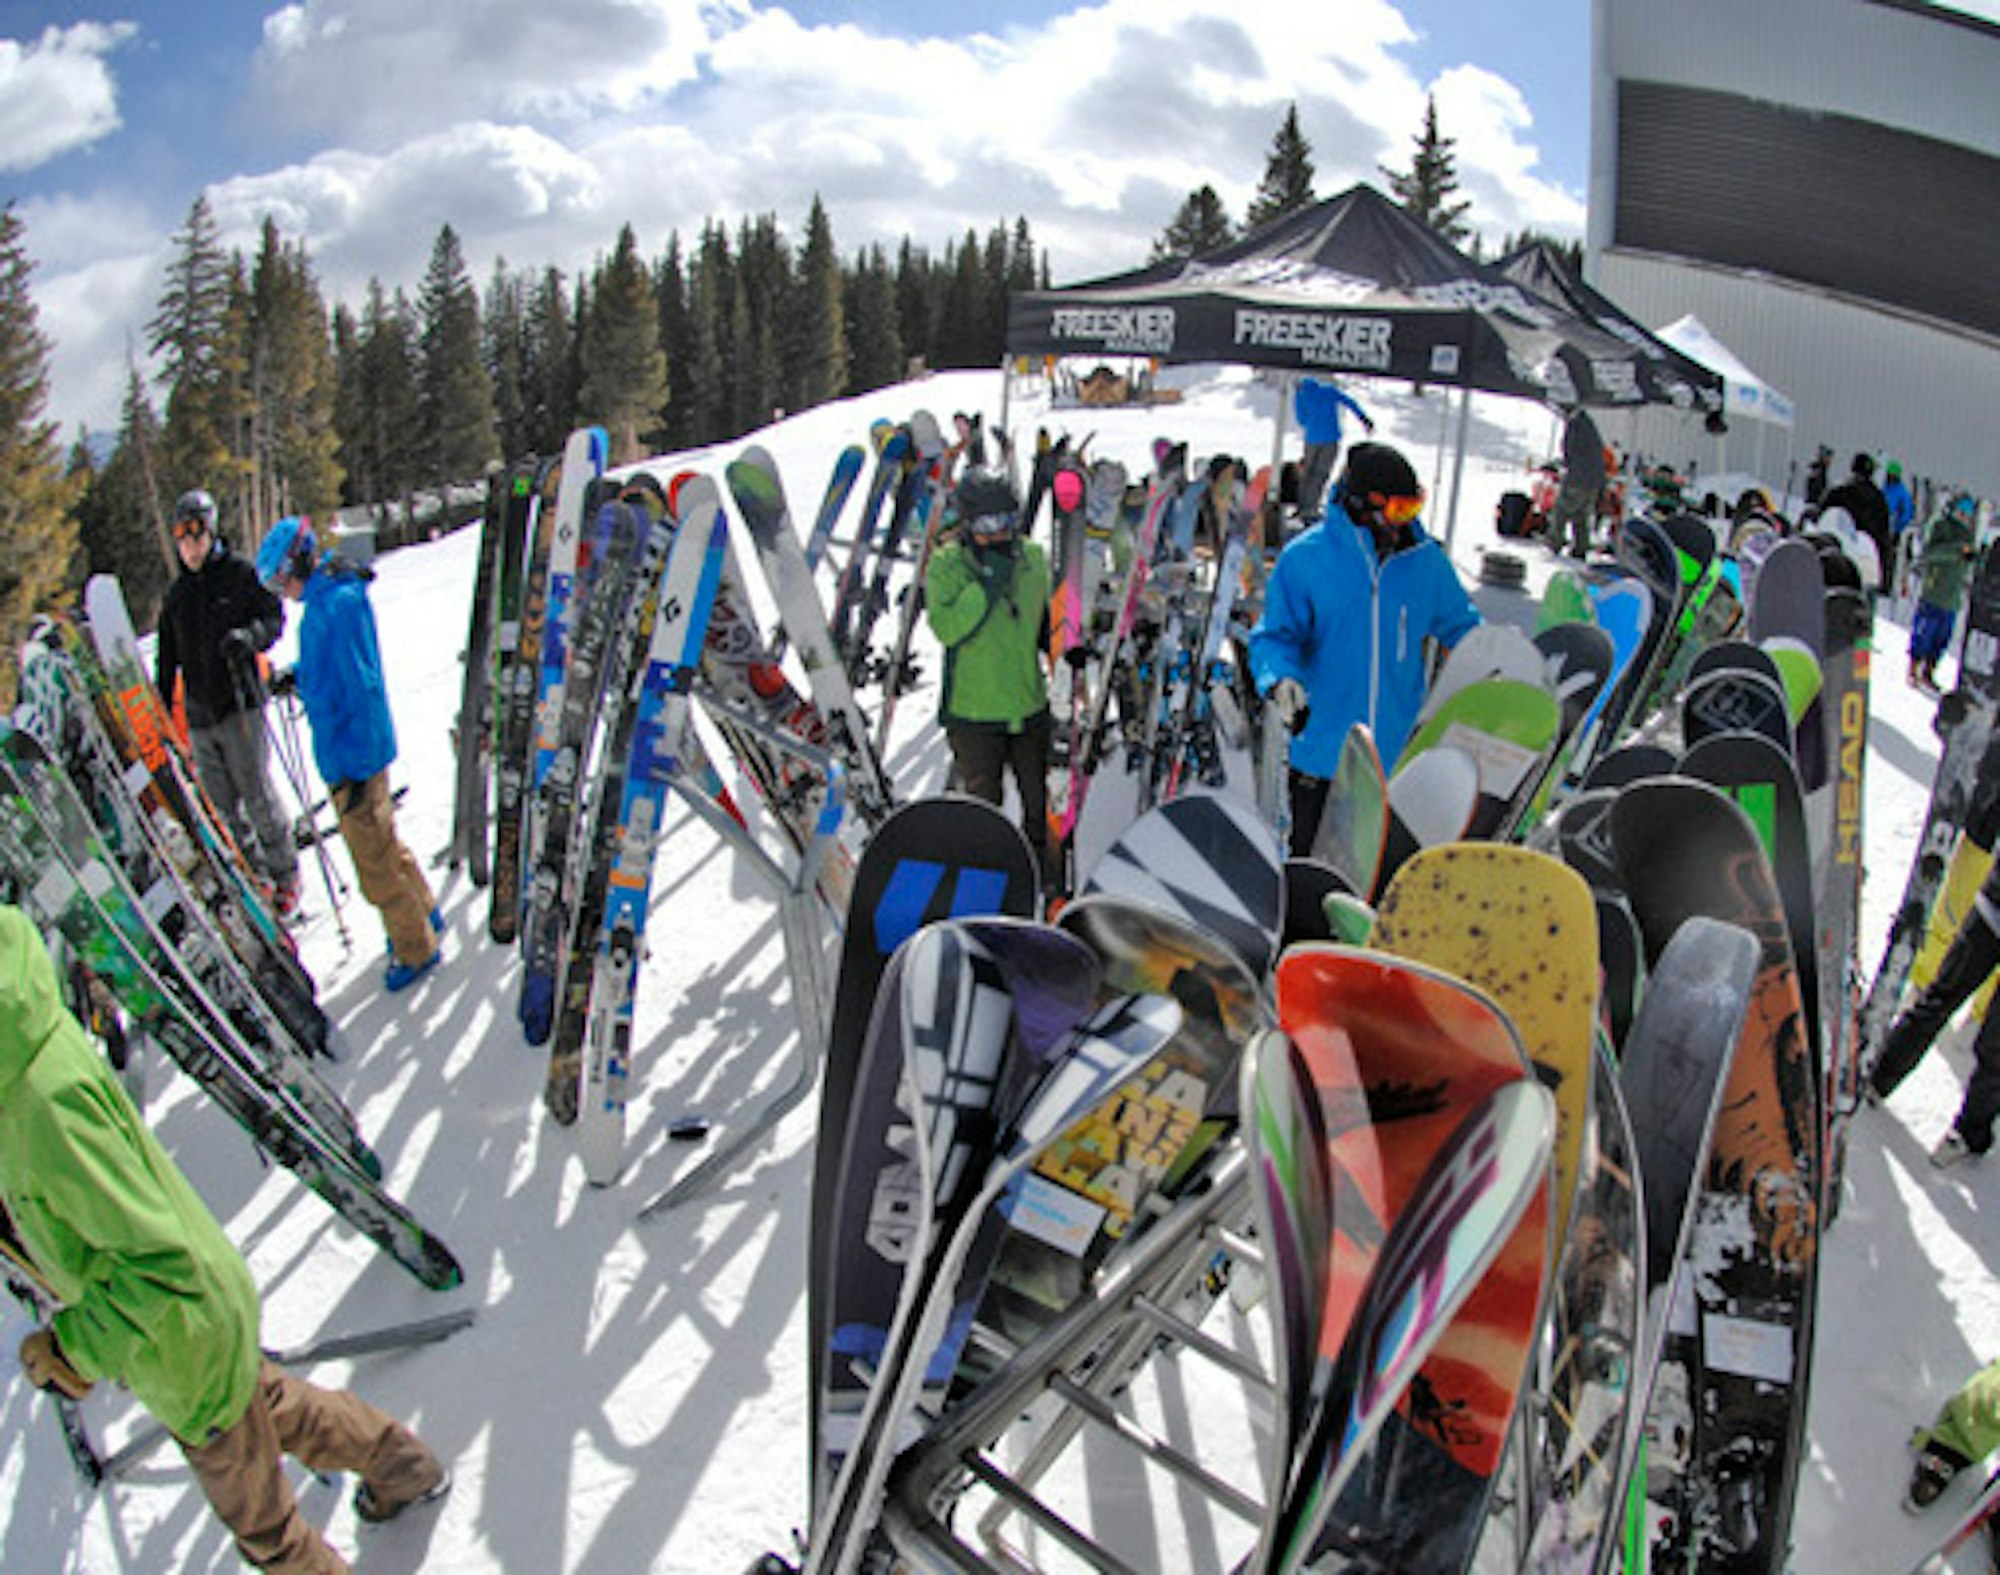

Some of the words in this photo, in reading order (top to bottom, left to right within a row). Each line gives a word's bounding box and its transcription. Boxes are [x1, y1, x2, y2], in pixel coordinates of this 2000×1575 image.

[1050, 306, 1176, 342] FREESKIER
[1234, 309, 1392, 353] FREESKIER
[119, 684, 167, 773] SCOTT
[1836, 691, 1864, 864] HEAD
